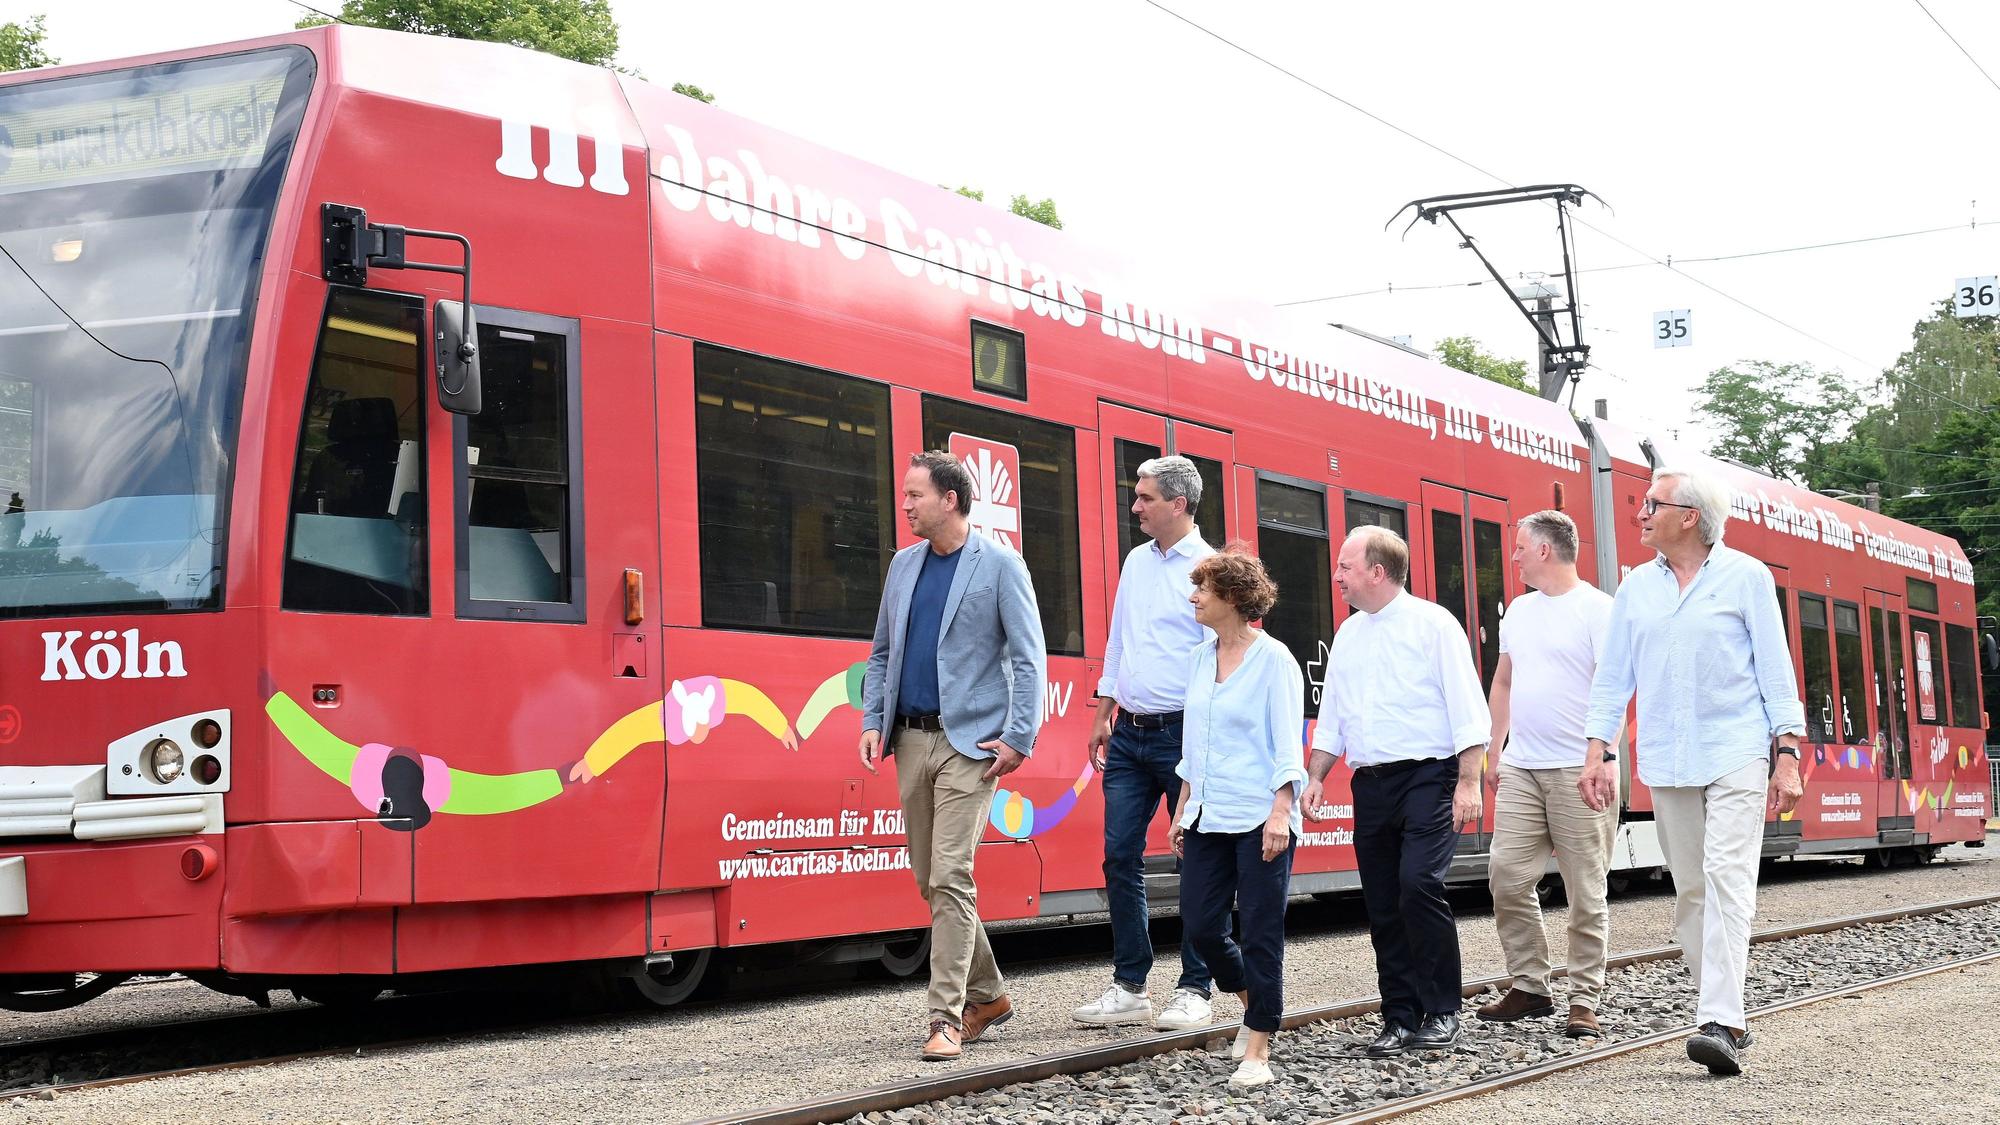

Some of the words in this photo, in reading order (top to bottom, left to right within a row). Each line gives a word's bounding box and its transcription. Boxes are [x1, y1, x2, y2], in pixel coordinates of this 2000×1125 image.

[660, 124, 867, 260] Jahre
[880, 198, 1087, 327] Caritas
[1961, 285, 1994, 307] 36
[1658, 318, 1687, 340] 35
[41, 628, 188, 681] Köln
[722, 812, 834, 841] Gemeinsam
[839, 809, 867, 836] für
